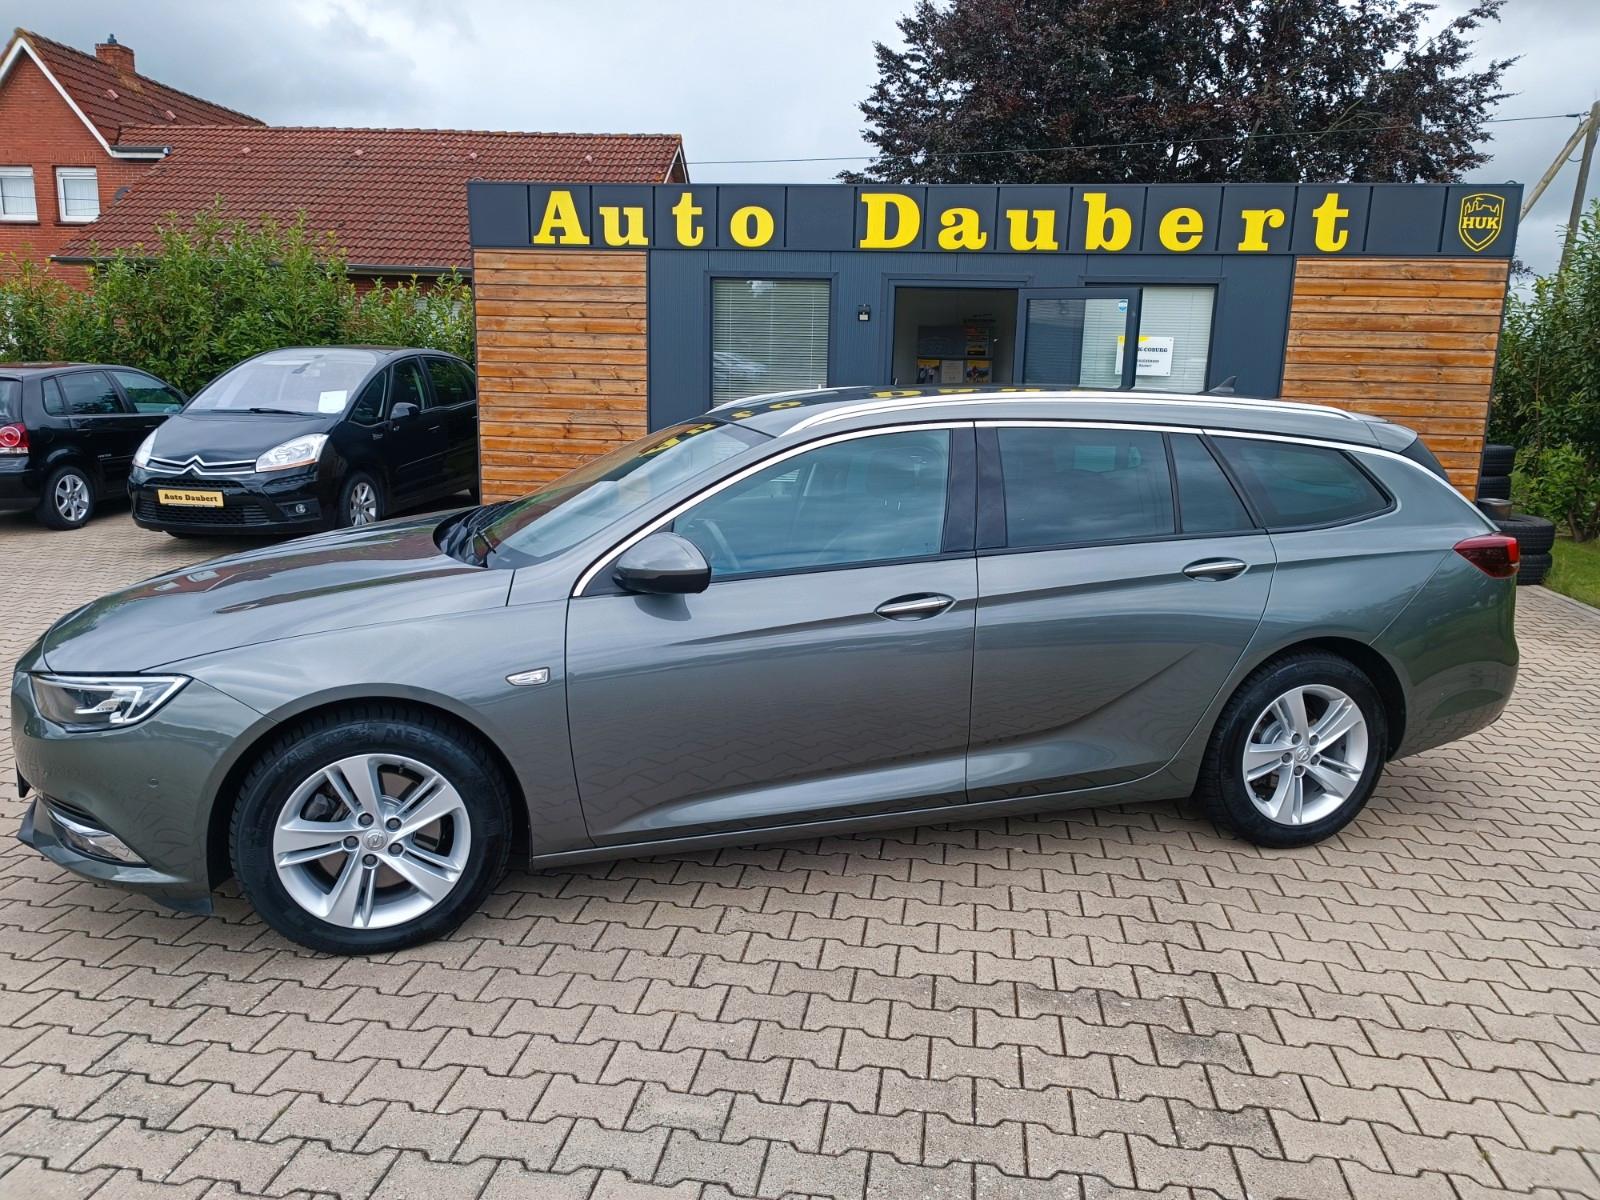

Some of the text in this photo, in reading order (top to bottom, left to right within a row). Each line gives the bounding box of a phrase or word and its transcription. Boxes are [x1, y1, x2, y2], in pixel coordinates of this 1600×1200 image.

[533, 190, 1349, 252] Auto Daubert
[1461, 216, 1499, 229] HUK
[185, 494, 218, 502] Daubert
